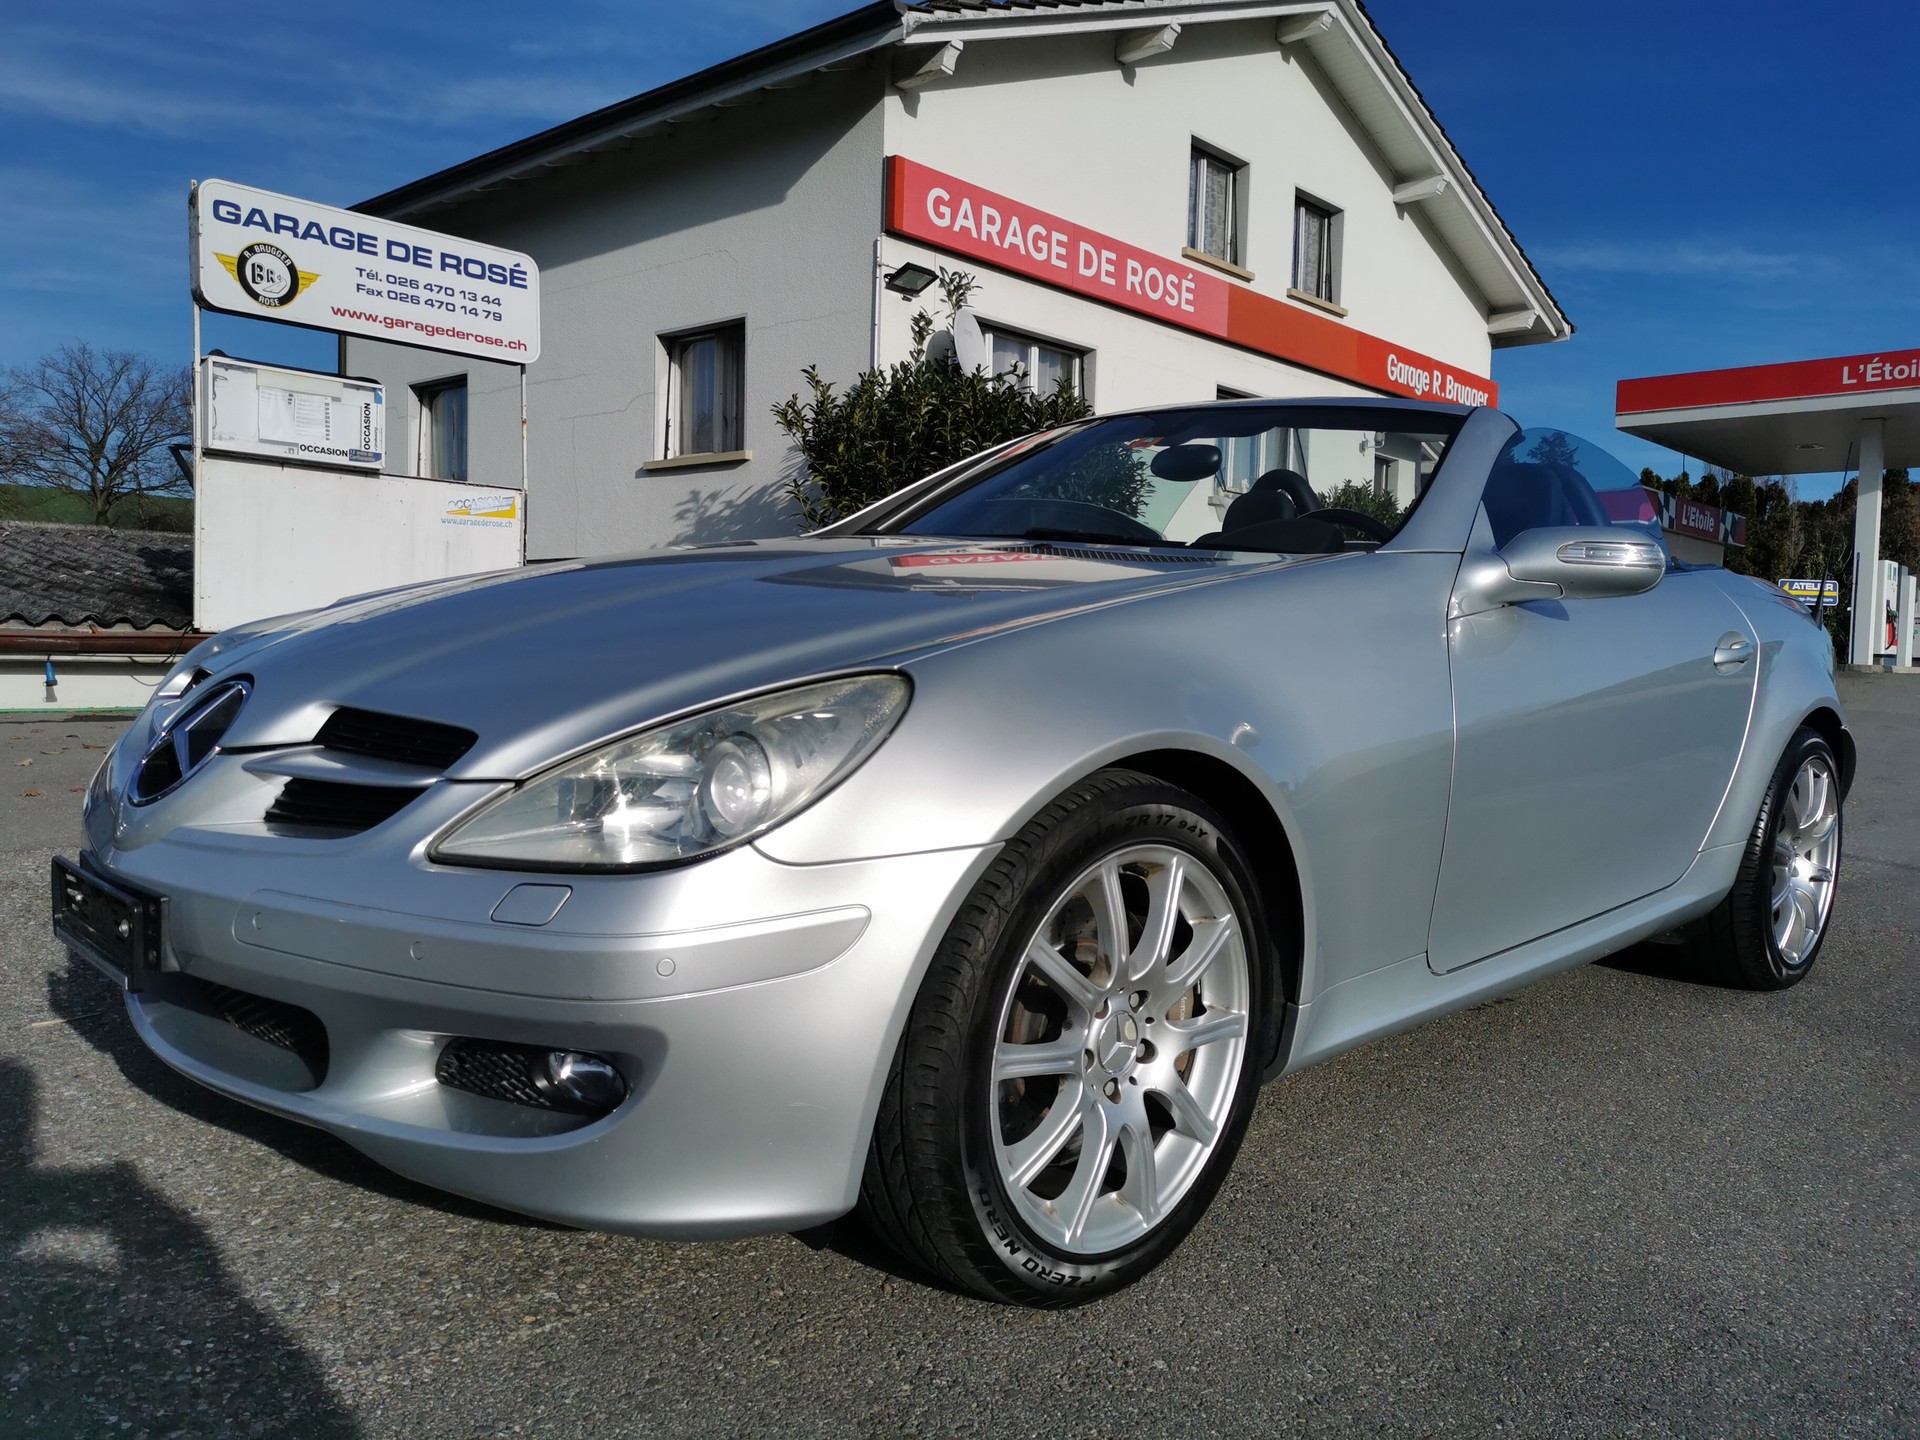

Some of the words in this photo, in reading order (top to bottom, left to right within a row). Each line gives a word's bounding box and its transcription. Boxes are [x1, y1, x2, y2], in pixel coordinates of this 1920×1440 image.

[213, 200, 378, 257] GARAGE
[387, 240, 432, 269] DE
[440, 252, 528, 290] ROSÉ
[254, 244, 292, 266] BRUGGER
[927, 187, 1068, 270] GARAGE
[1078, 240, 1117, 286] DE
[1126, 258, 1196, 313] ROSÉ
[258, 295, 280, 306] ROSE
[355, 267, 383, 282] Tél.
[386, 274, 419, 289] 026
[423, 283, 455, 297] 470
[459, 290, 478, 301] 13
[481, 296, 502, 307] 44
[356, 283, 384, 298] Fax
[387, 290, 420, 305] 026
[424, 299, 456, 312] 470
[460, 306, 479, 317] 14
[482, 310, 502, 321] 79
[331, 306, 528, 351] www.garagederose.ch
[1387, 353, 1430, 396] Garage
[1842, 357, 1920, 385] L'Étoi
[363, 402, 371, 450] OCCASION
[300, 444, 348, 457] OCCASION
[1681, 504, 1715, 532] L'Etoile
[1792, 582, 1834, 591] ATELIR
[1155, 814, 1176, 826] 17
[1177, 819, 1209, 839] 94Y
